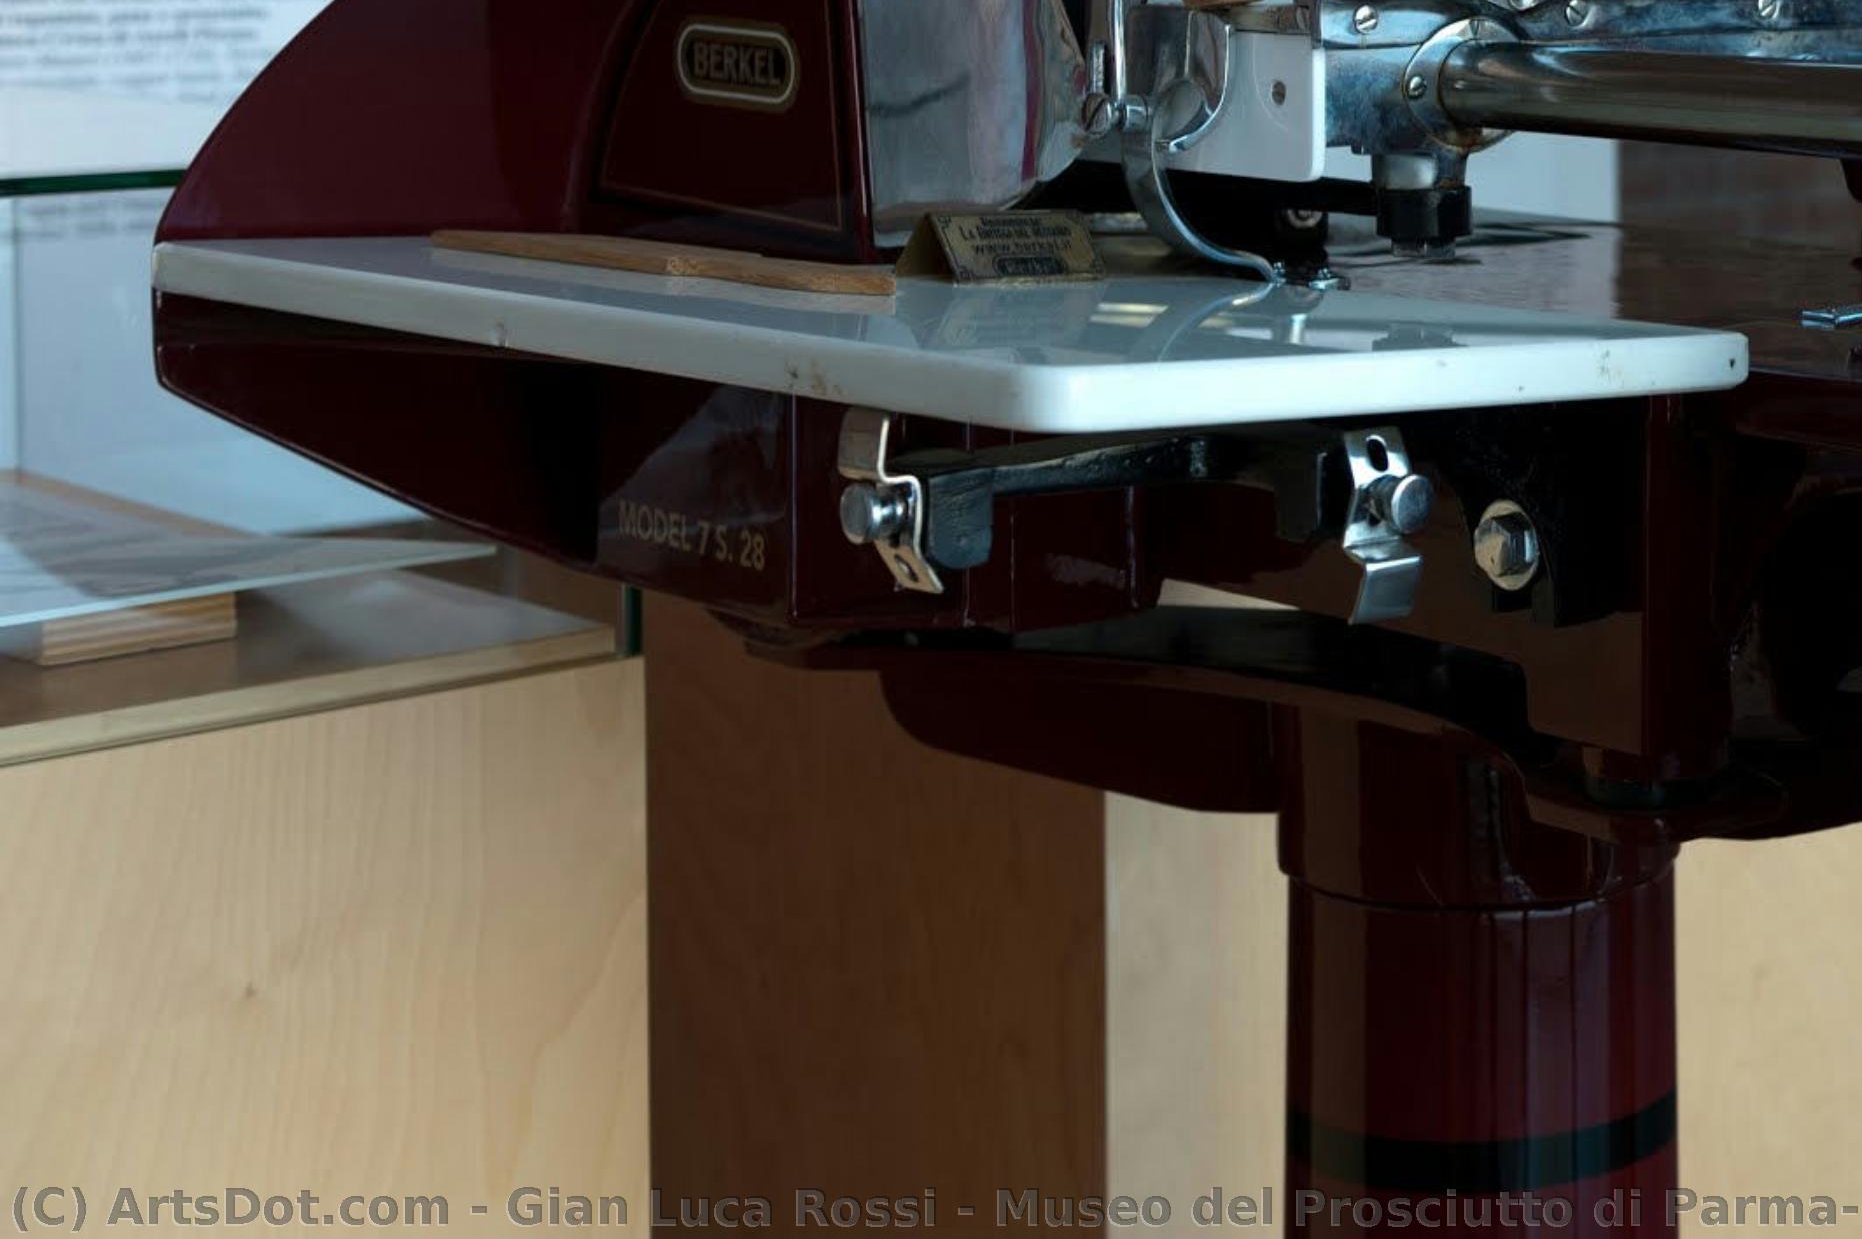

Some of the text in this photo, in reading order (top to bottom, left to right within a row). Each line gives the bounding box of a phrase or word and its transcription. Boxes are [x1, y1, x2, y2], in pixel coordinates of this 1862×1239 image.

[693, 41, 782, 87] BERKEL
[618, 499, 692, 552] MODEL
[739, 527, 766, 572] 28
